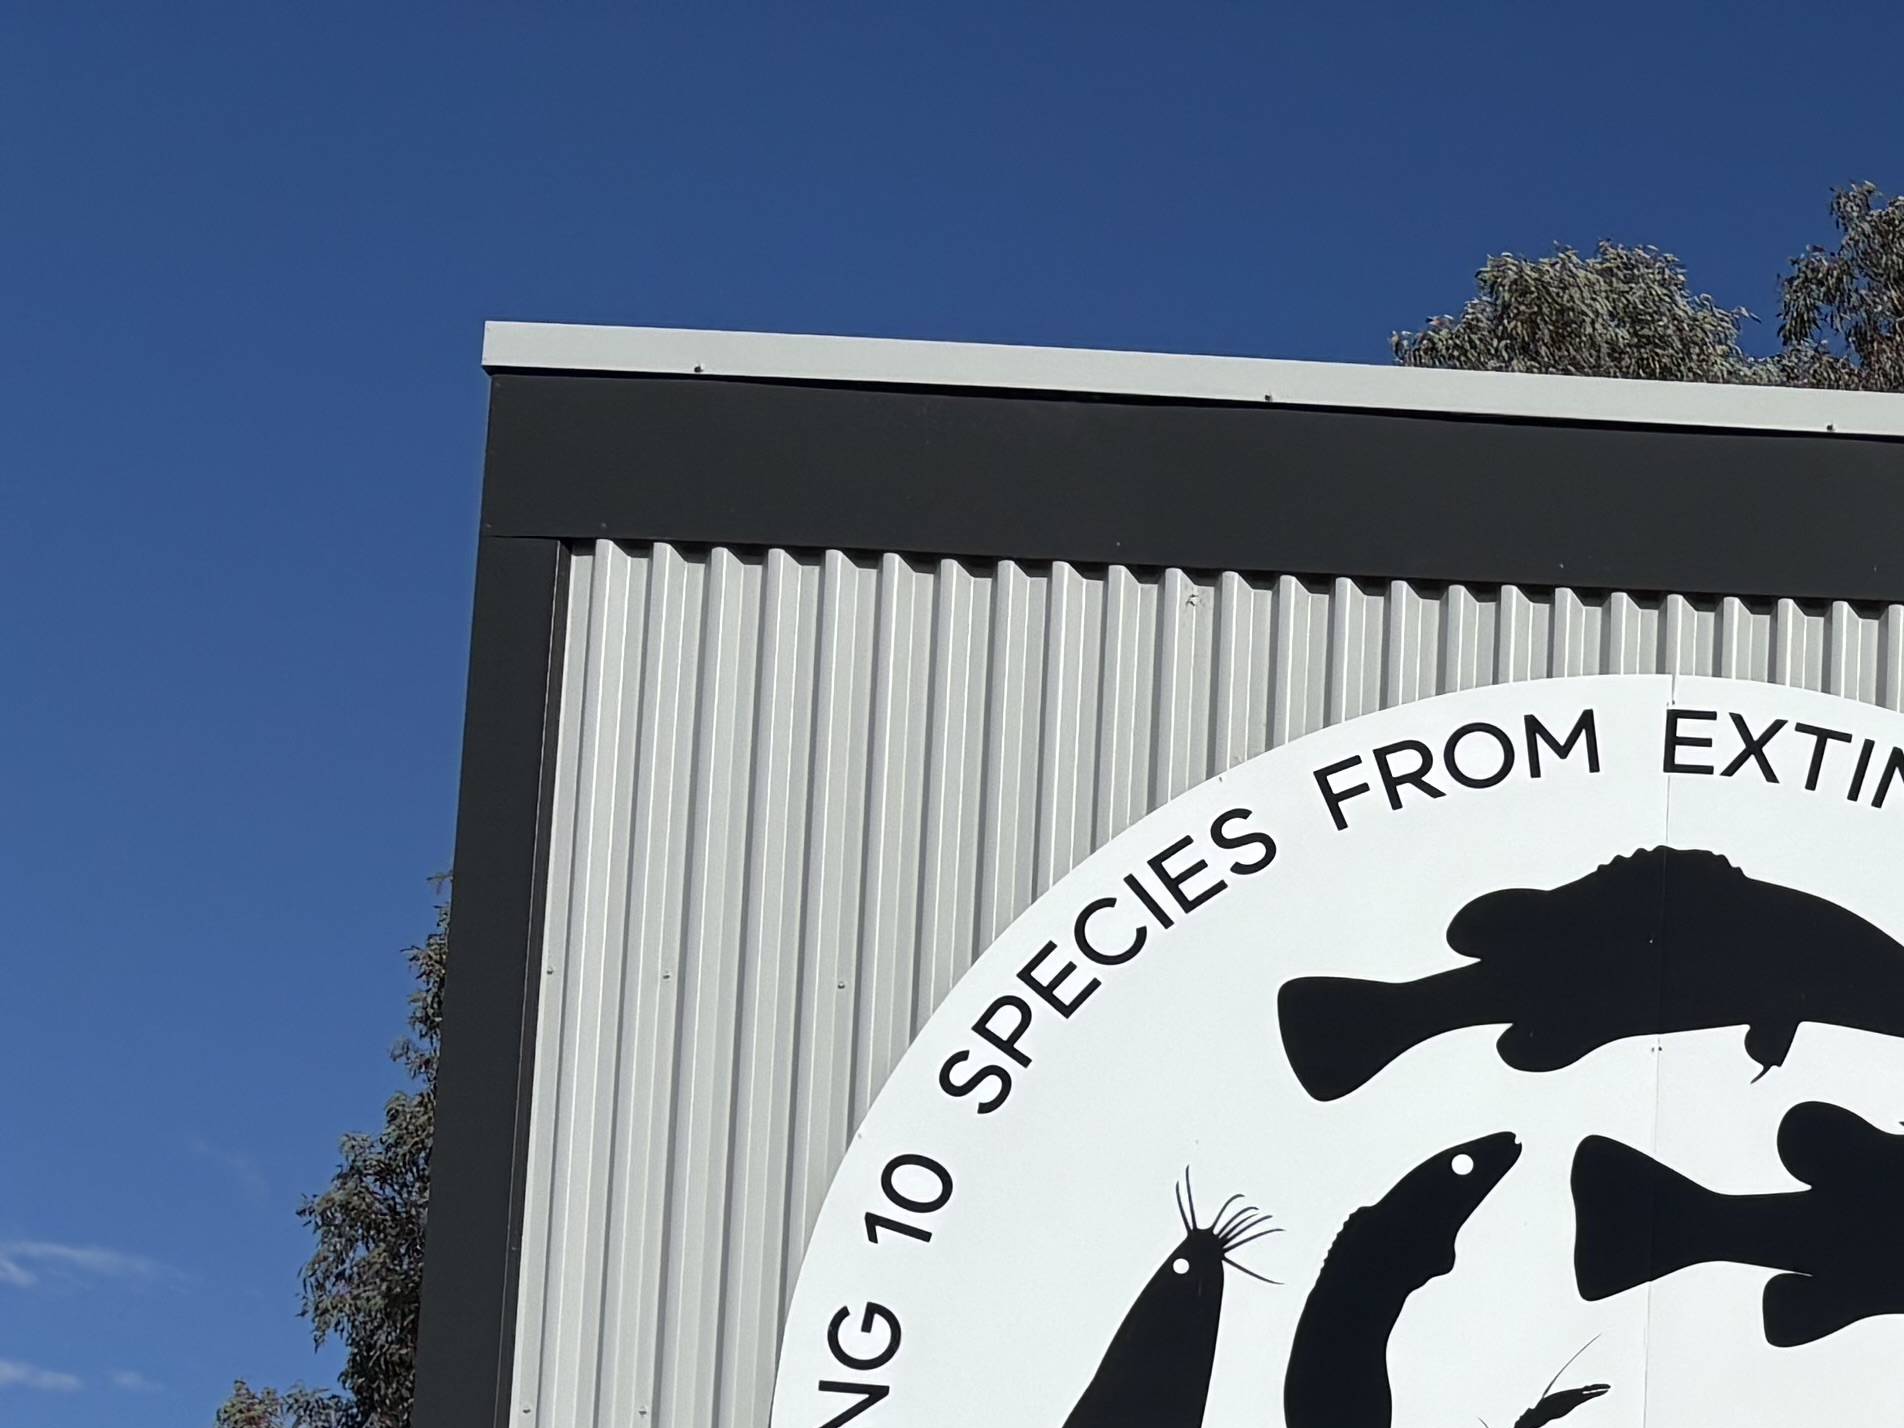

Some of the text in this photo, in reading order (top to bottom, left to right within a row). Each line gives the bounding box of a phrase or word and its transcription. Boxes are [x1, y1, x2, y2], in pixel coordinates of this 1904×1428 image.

[865, 1153, 953, 1244] 10
[938, 808, 1277, 1115] SPECIES
[1312, 708, 1601, 831] FROM
